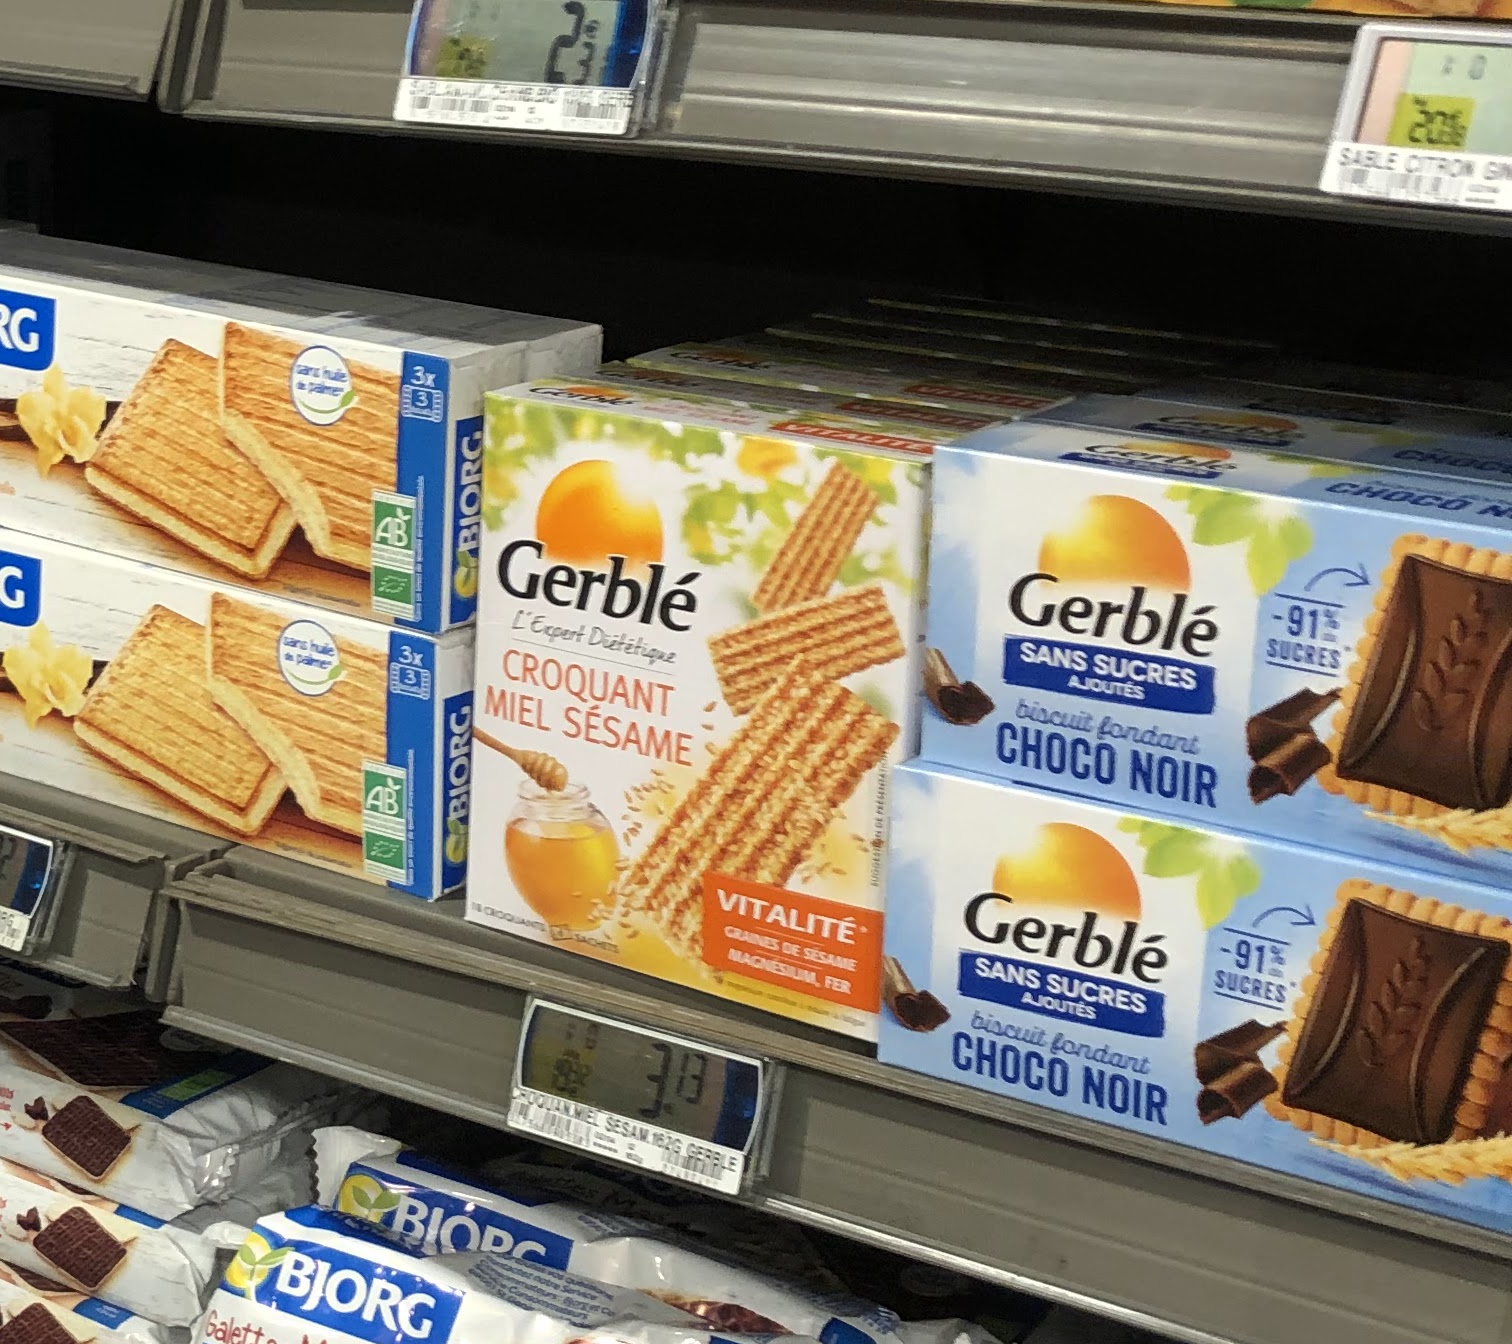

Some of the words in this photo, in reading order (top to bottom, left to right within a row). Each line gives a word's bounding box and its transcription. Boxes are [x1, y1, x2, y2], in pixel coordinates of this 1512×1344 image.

[1339, 147, 1399, 171] SABLE
[459, 431, 483, 554] BJORG
[498, 538, 697, 633] Gerblé
[513, 608, 584, 646] L'Expert
[1009, 573, 1221, 657] Gerblé
[502, 648, 675, 717] CROQUANT
[1020, 641, 1091, 675] SANS
[1096, 654, 1197, 691] SUCRES
[1068, 671, 1146, 701] AJOUTÉS
[485, 684, 551, 730] MIEL
[564, 703, 693, 767] SÉSAME
[996, 722, 1113, 786] CHOCO
[1129, 748, 1218, 808] NOIR
[1016, 698, 1092, 733] biscuit
[1095, 714, 1200, 755] fondant
[964, 892, 1169, 984] Gerblé
[975, 955, 1042, 990] SANS
[1046, 971, 1148, 1015] SUCRES
[952, 1032, 1068, 1099] CHOCO
[1081, 1065, 1168, 1126] NOIR
[275, 1253, 437, 1341] BJORG
